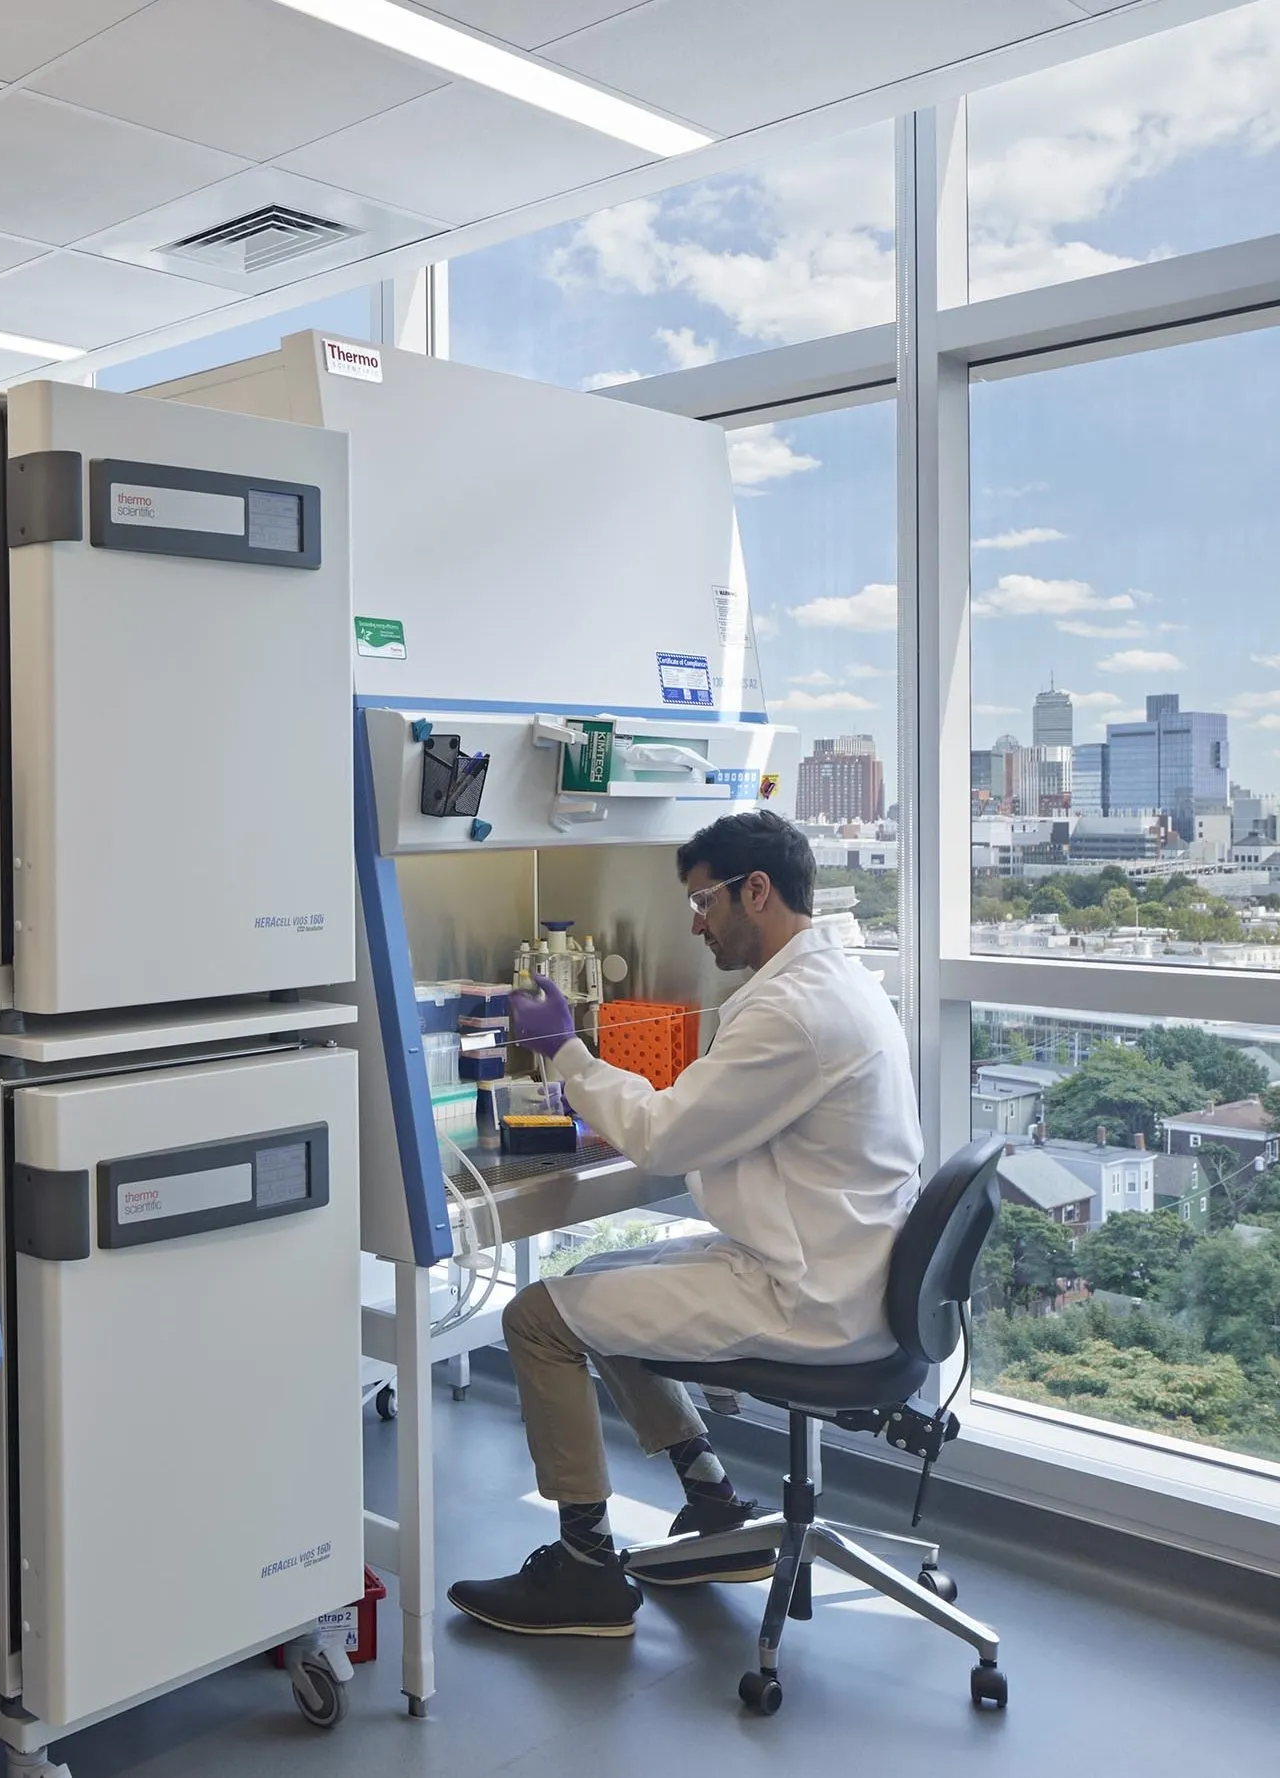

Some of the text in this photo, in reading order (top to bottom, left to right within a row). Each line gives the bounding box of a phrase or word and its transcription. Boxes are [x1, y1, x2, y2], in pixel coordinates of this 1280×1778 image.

[328, 343, 378, 368] Thermo
[118, 492, 152, 507] thermo
[117, 506, 155, 519] scientific
[595, 731, 606, 783] KIMTECH
[254, 916, 291, 928] HERACELL
[124, 1189, 159, 1203] thermo
[124, 1199, 162, 1216] scientific
[261, 1557, 298, 1578] HERACELL
[300, 1548, 315, 1563] VIOS
[318, 1611, 352, 1623] ctrap 2
